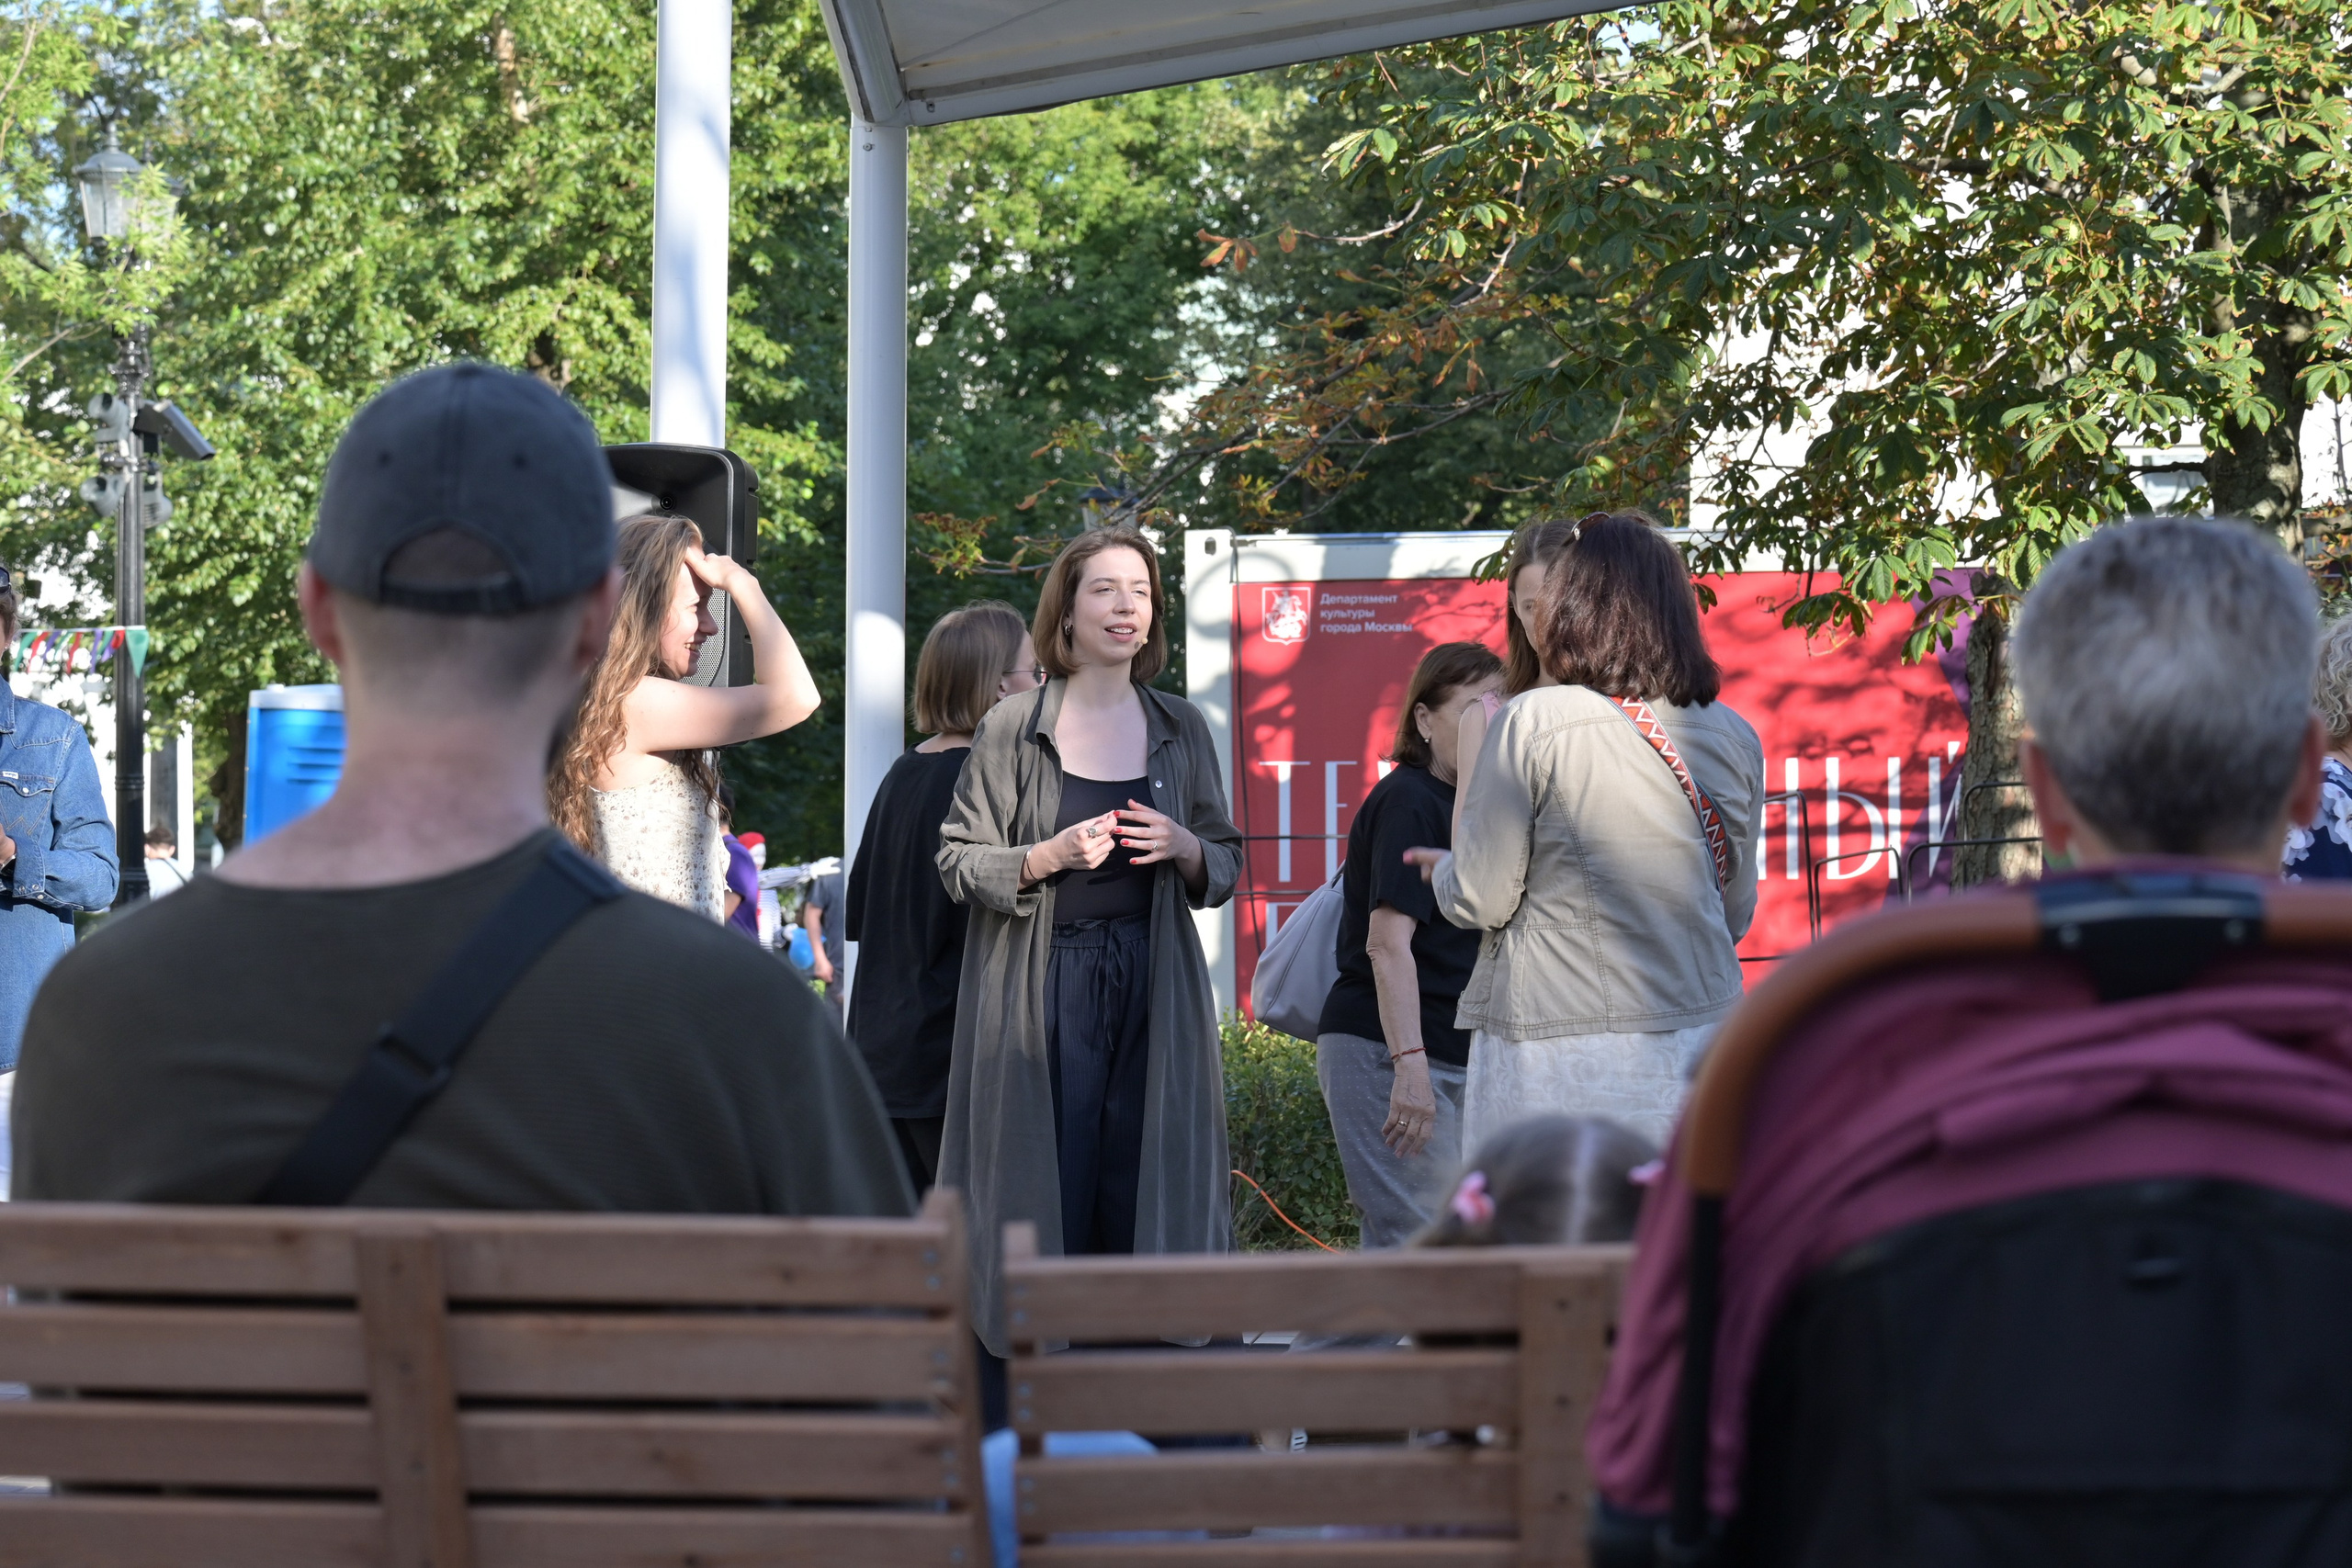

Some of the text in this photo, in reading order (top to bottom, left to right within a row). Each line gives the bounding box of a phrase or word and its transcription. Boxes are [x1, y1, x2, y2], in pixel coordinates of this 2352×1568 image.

[1320, 593, 1397, 605] Департамент
[1320, 610, 1375, 620] культуры
[1320, 622, 1412, 635] города Москвы
